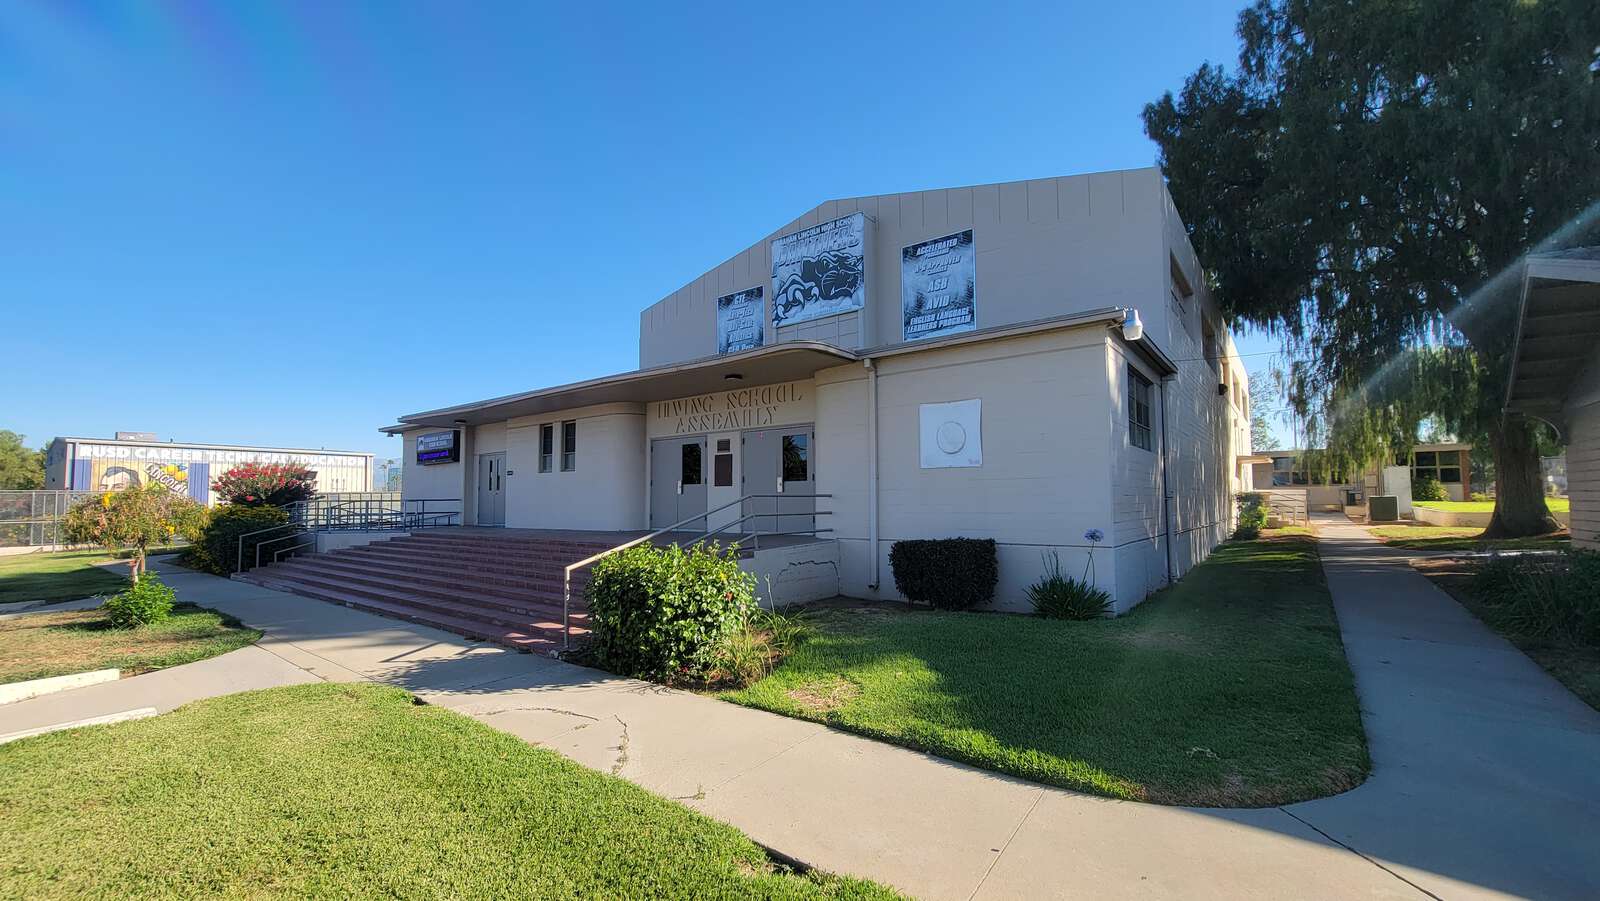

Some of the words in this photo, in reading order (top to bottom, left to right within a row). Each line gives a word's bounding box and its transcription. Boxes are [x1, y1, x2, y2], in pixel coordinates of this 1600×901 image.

[926, 295, 951, 310] AVID
[726, 383, 803, 409] SCHOOL
[79, 445, 130, 458] RUSD
[145, 463, 187, 493] LINCOLN
